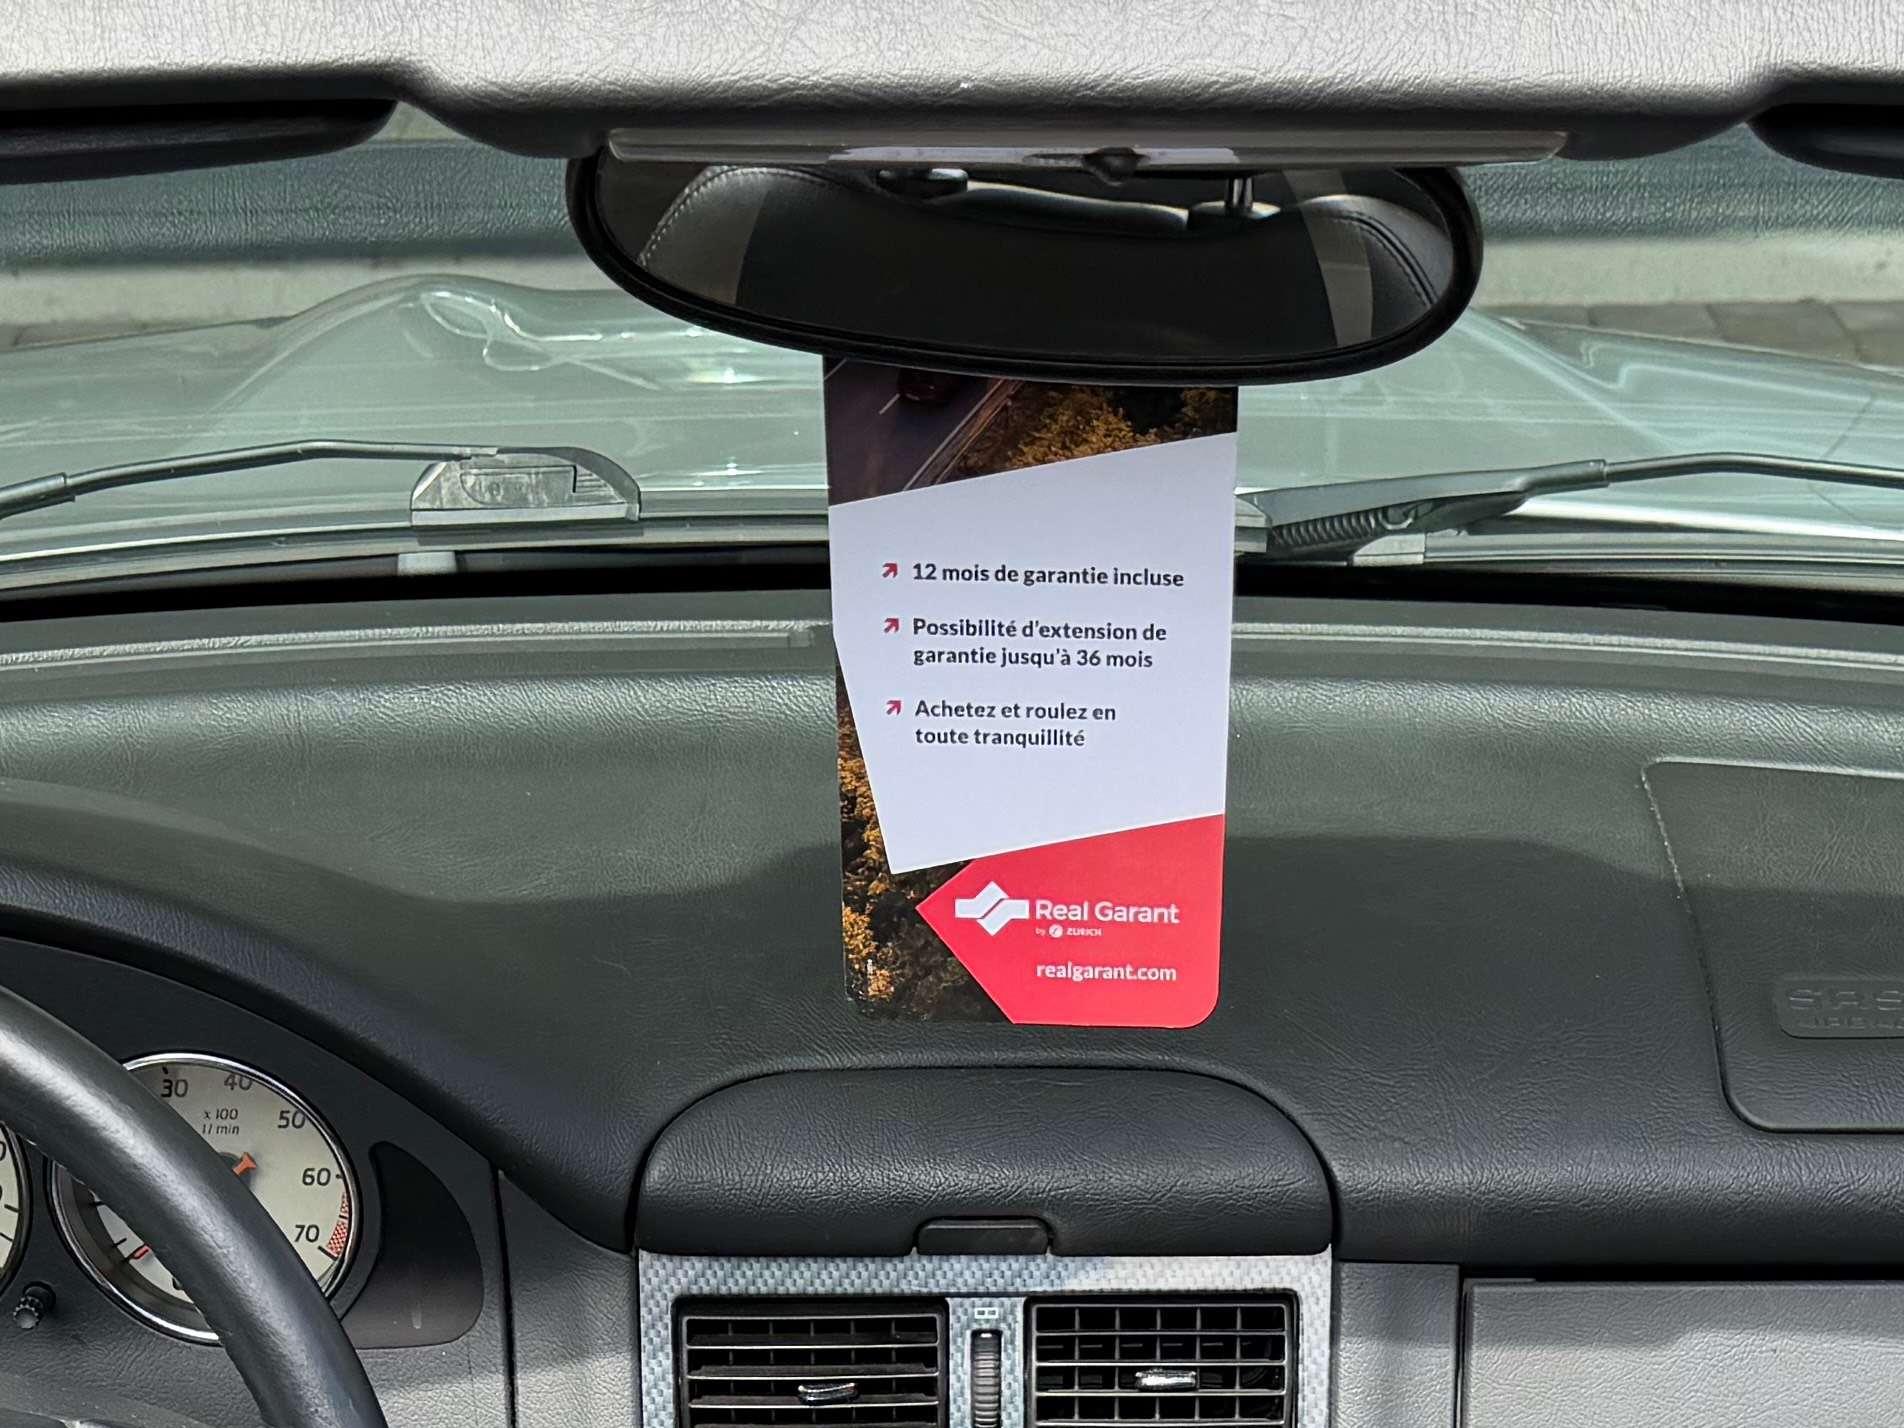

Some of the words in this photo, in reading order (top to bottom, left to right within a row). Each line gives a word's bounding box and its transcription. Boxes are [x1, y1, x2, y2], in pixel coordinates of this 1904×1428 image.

[912, 563, 937, 580] 12
[942, 565, 989, 582] mois
[995, 564, 1019, 582] de
[1023, 566, 1108, 587] garantie
[1113, 568, 1185, 586] incluse
[913, 618, 1017, 637] Possibilité
[1022, 620, 1137, 640] d'extension
[1142, 623, 1167, 641] de
[913, 647, 996, 666] garantie
[1001, 648, 1070, 668] jusqu'à
[1076, 650, 1101, 666] 36
[1106, 651, 1153, 667] mois
[915, 700, 996, 718] Achetez
[1001, 703, 1021, 718] et
[1026, 703, 1088, 720] roulez
[1092, 707, 1116, 721] en
[915, 729, 969, 745] toute
[974, 729, 1085, 748] tranquillité
[1036, 900, 1088, 920] Real
[1095, 901, 1180, 923] Garant
[1036, 928, 1045, 936] by
[1037, 961, 1177, 981] realgarant.com
[160, 1078, 188, 1097] 30
[223, 1072, 252, 1091] 40
[216, 1108, 238, 1120] 100
[277, 1110, 306, 1129] 50
[302, 1167, 331, 1186] 60
[294, 1224, 320, 1243] 70
